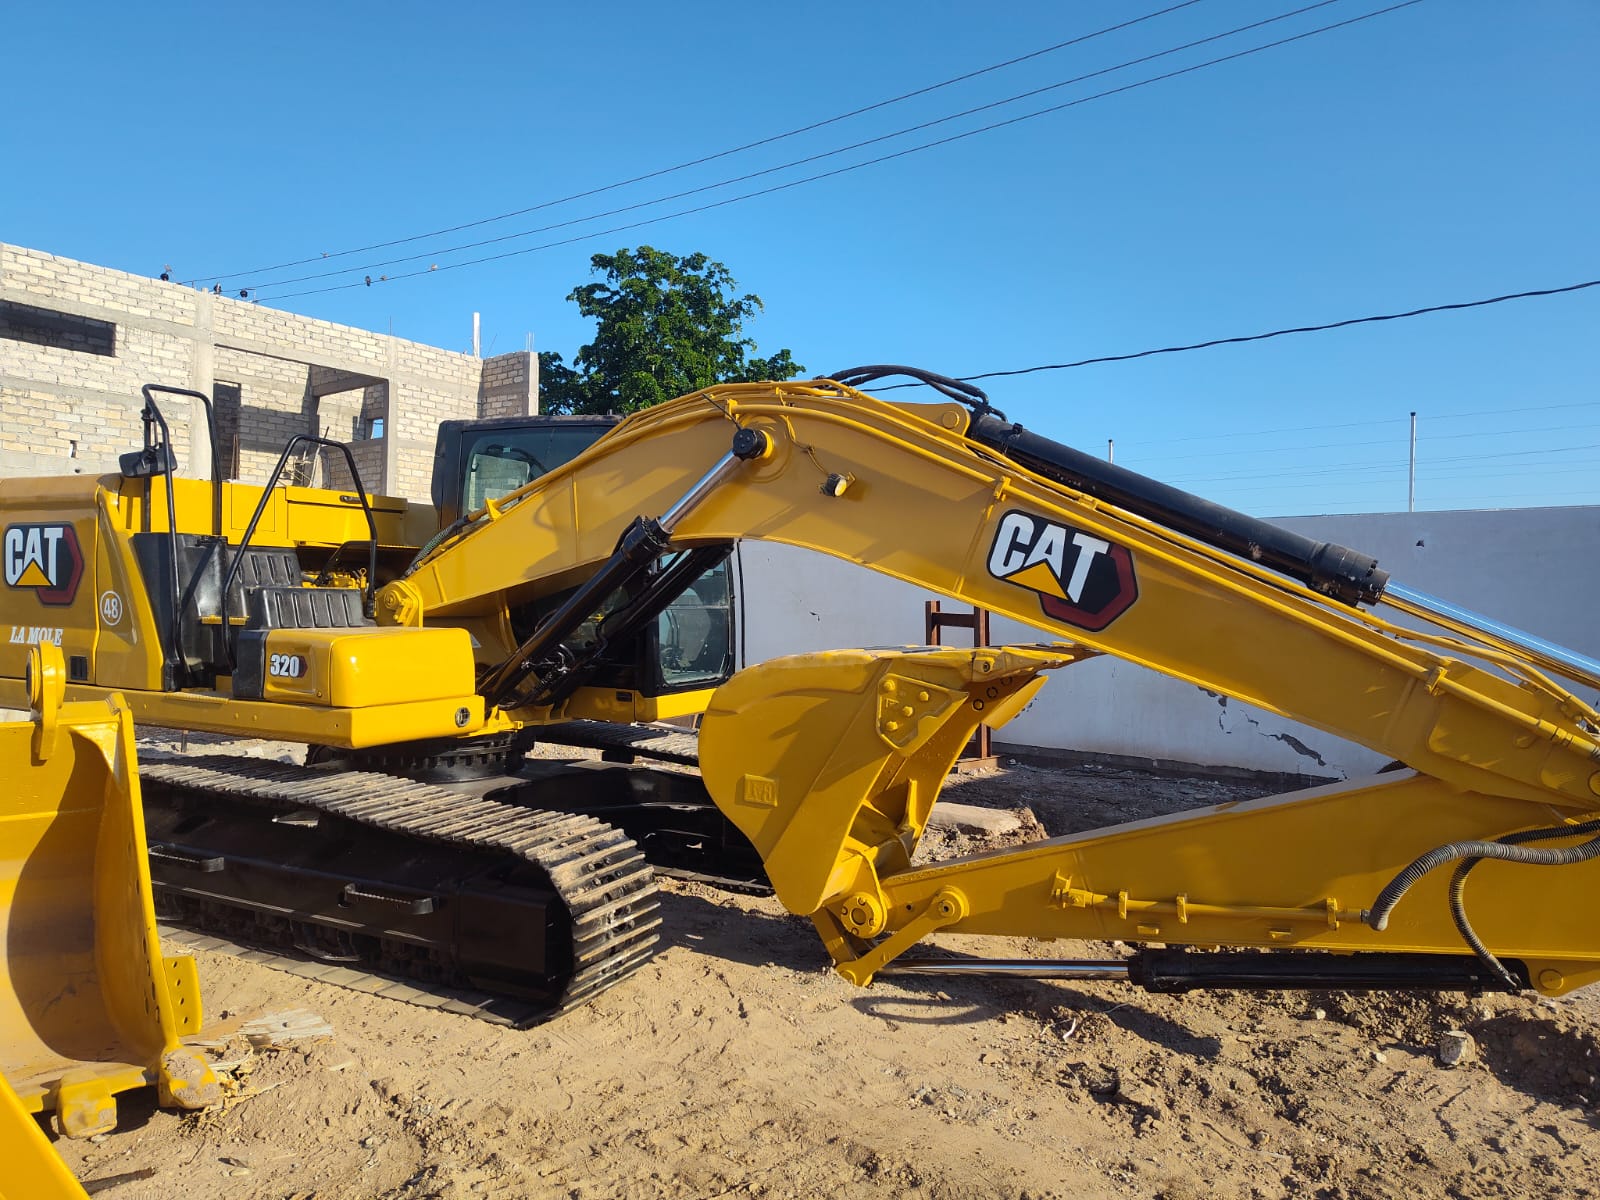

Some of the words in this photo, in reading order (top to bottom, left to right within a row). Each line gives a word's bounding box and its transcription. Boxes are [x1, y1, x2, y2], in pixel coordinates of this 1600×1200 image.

[5, 527, 64, 586] CAT
[989, 513, 1110, 603] CAT
[104, 598, 118, 618] 48
[9, 626, 25, 643] LA
[27, 627, 64, 646] MOLE
[270, 654, 300, 677] 320
